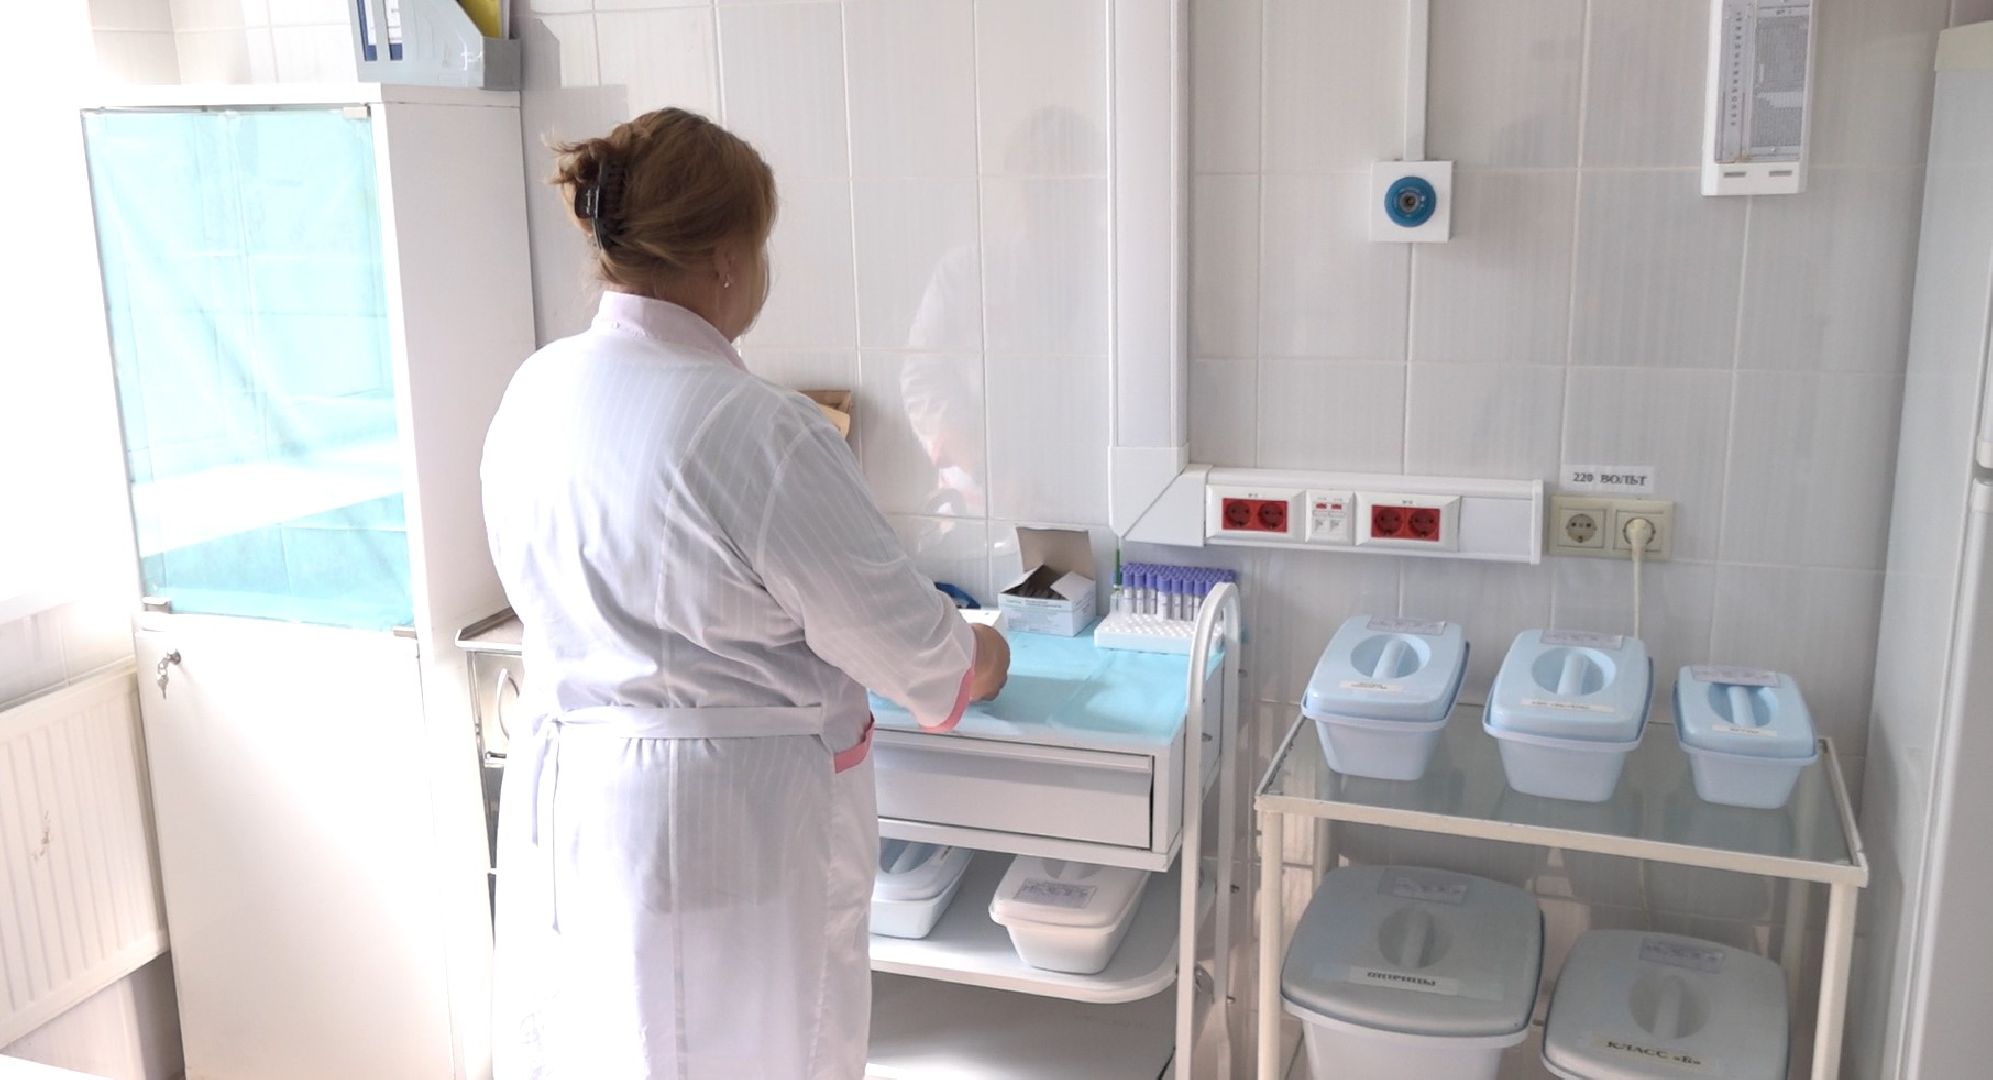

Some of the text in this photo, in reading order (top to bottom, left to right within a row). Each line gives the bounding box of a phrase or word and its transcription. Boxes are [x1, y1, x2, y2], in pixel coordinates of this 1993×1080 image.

[1573, 471, 1647, 486] 220 ВОЛЬТ
[1606, 1040, 1669, 1060] КЛАСС
